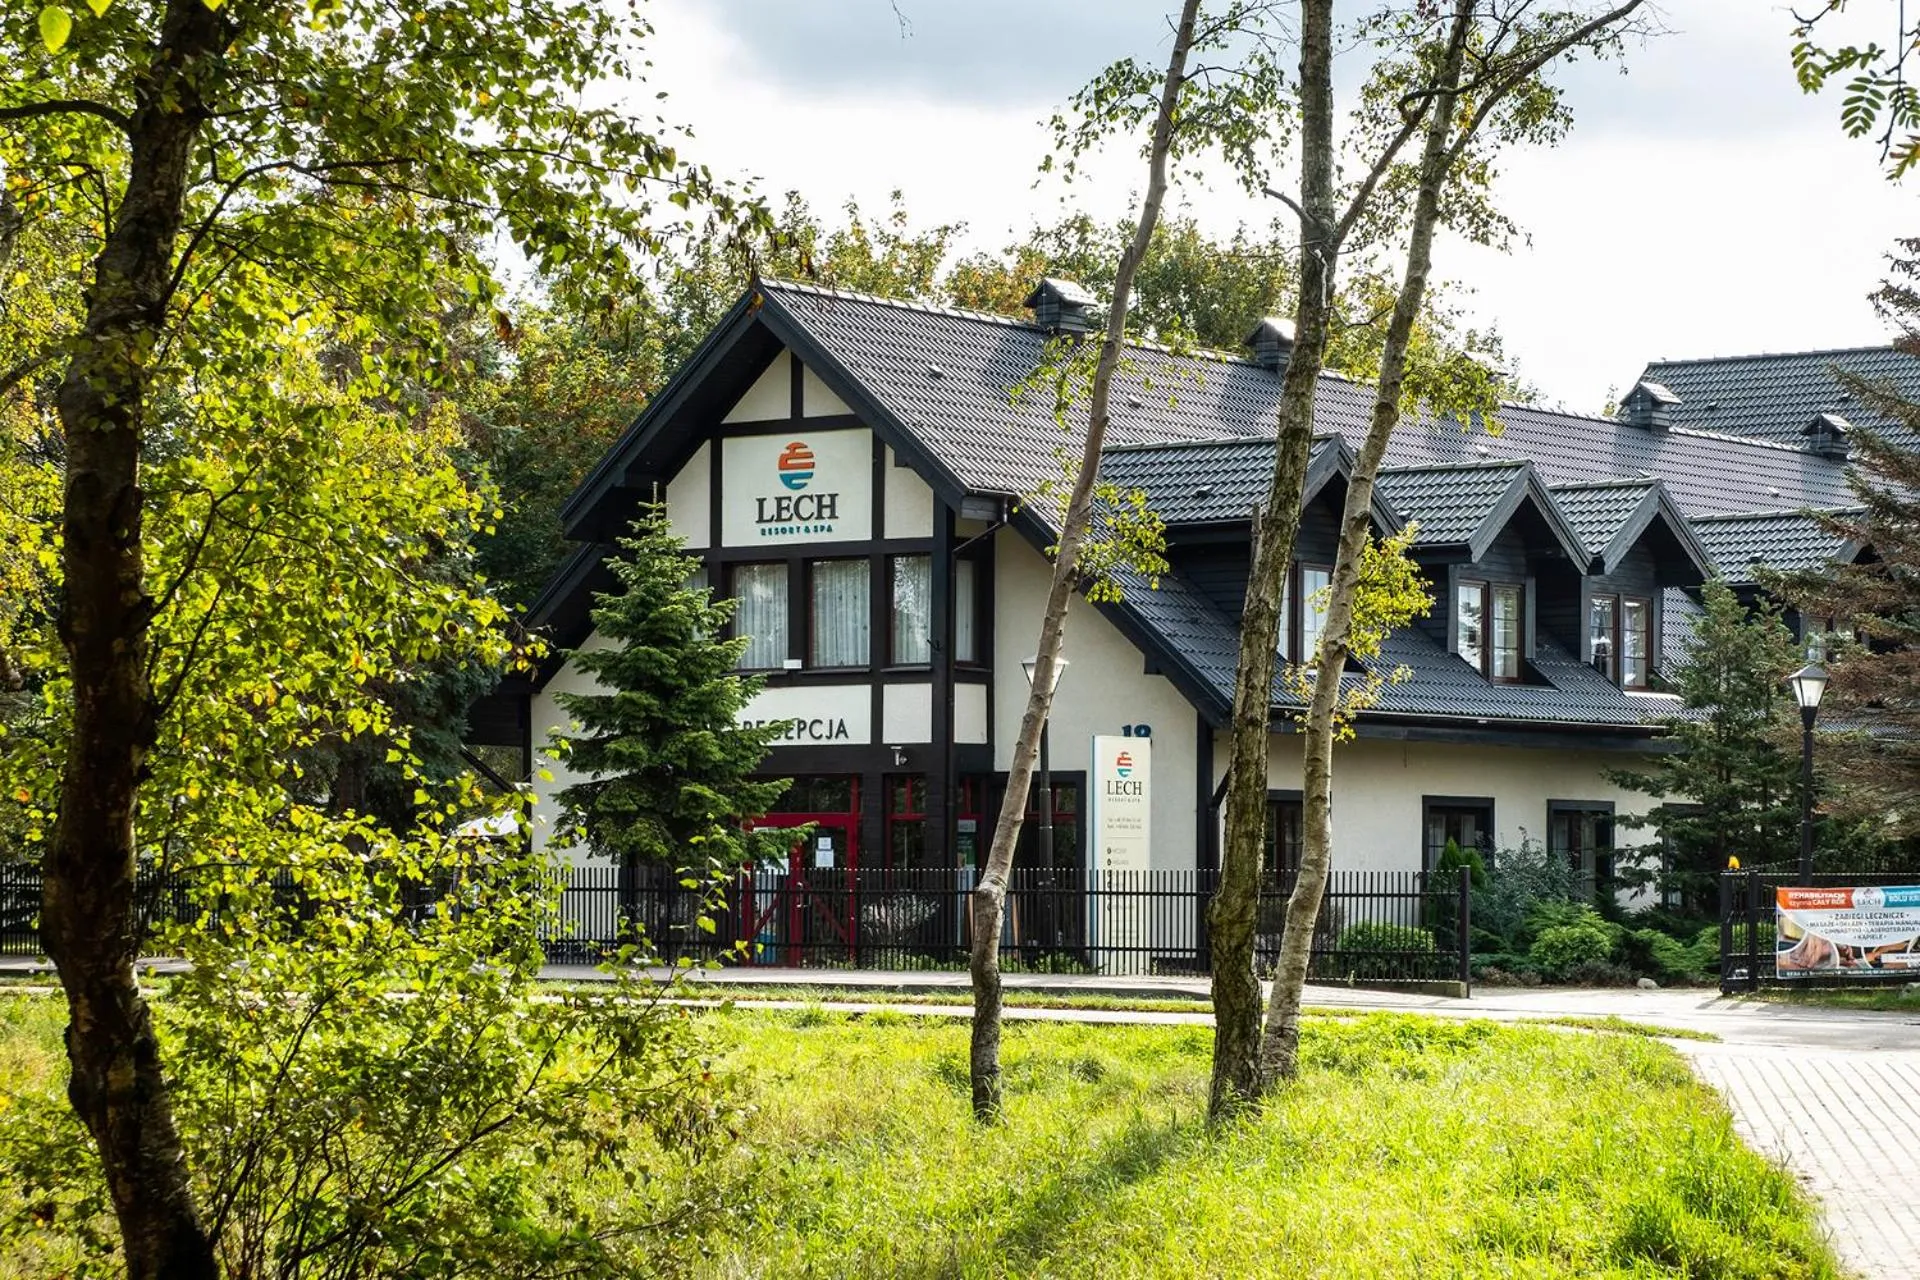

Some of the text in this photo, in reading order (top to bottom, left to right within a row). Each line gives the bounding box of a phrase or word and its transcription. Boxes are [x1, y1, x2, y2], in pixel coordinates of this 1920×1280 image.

[755, 493, 839, 524] LECH
[761, 524, 832, 536] RESORT & SPA
[1107, 780, 1142, 795] LECH
